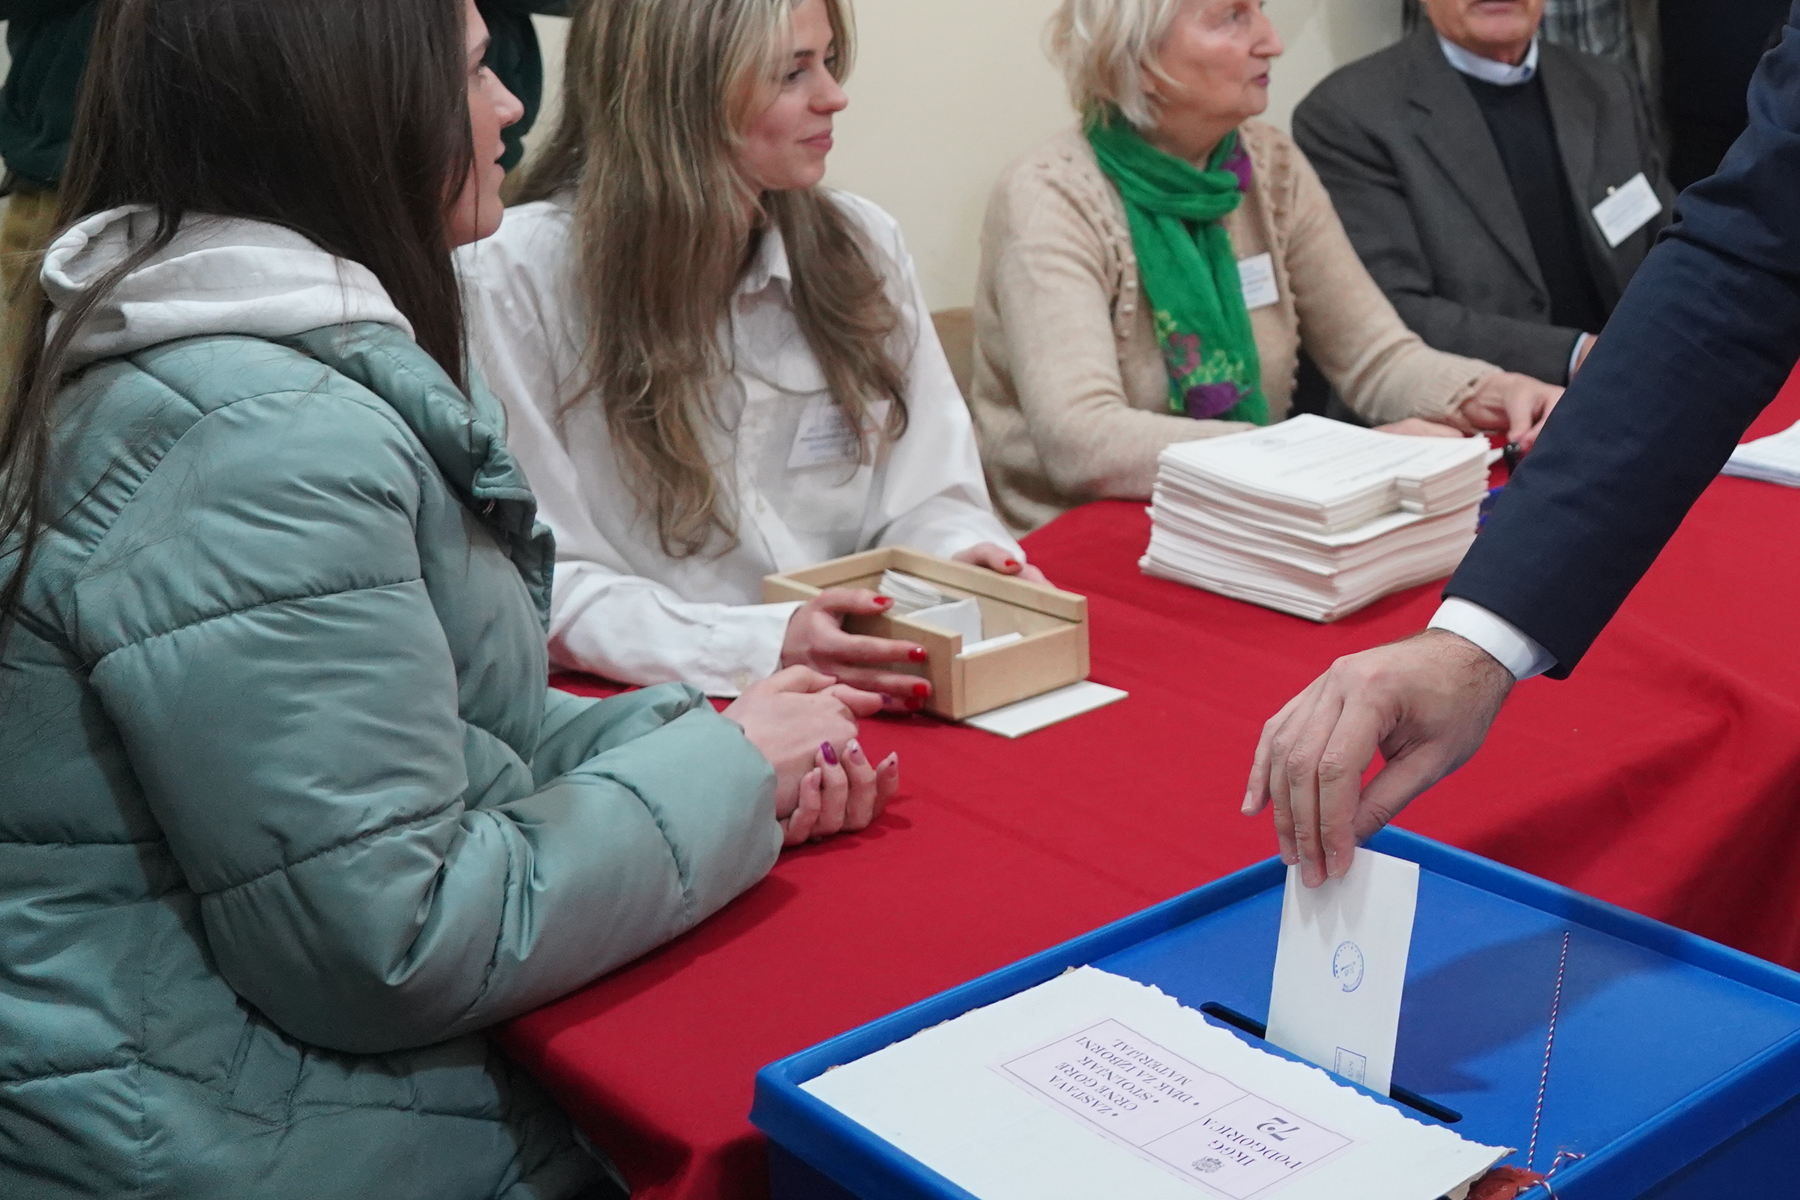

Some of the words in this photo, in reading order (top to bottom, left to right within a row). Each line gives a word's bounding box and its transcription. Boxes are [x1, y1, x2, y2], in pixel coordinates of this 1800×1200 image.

[1075, 1037, 1137, 1072] IZBORNI
[1112, 1039, 1192, 1086] MATERIJAL
[1055, 1062, 1097, 1087] GORE
[1077, 1056, 1153, 1100] STOLNJAK
[1136, 1070, 1158, 1084] ZA
[1049, 1075, 1113, 1114] ZASTAVA
[1095, 1086, 1138, 1110] CRNE
[1202, 1118, 1302, 1169] PODGORICA
[1256, 1117, 1300, 1141] 72
[1208, 1140, 1256, 1166] IKGG
